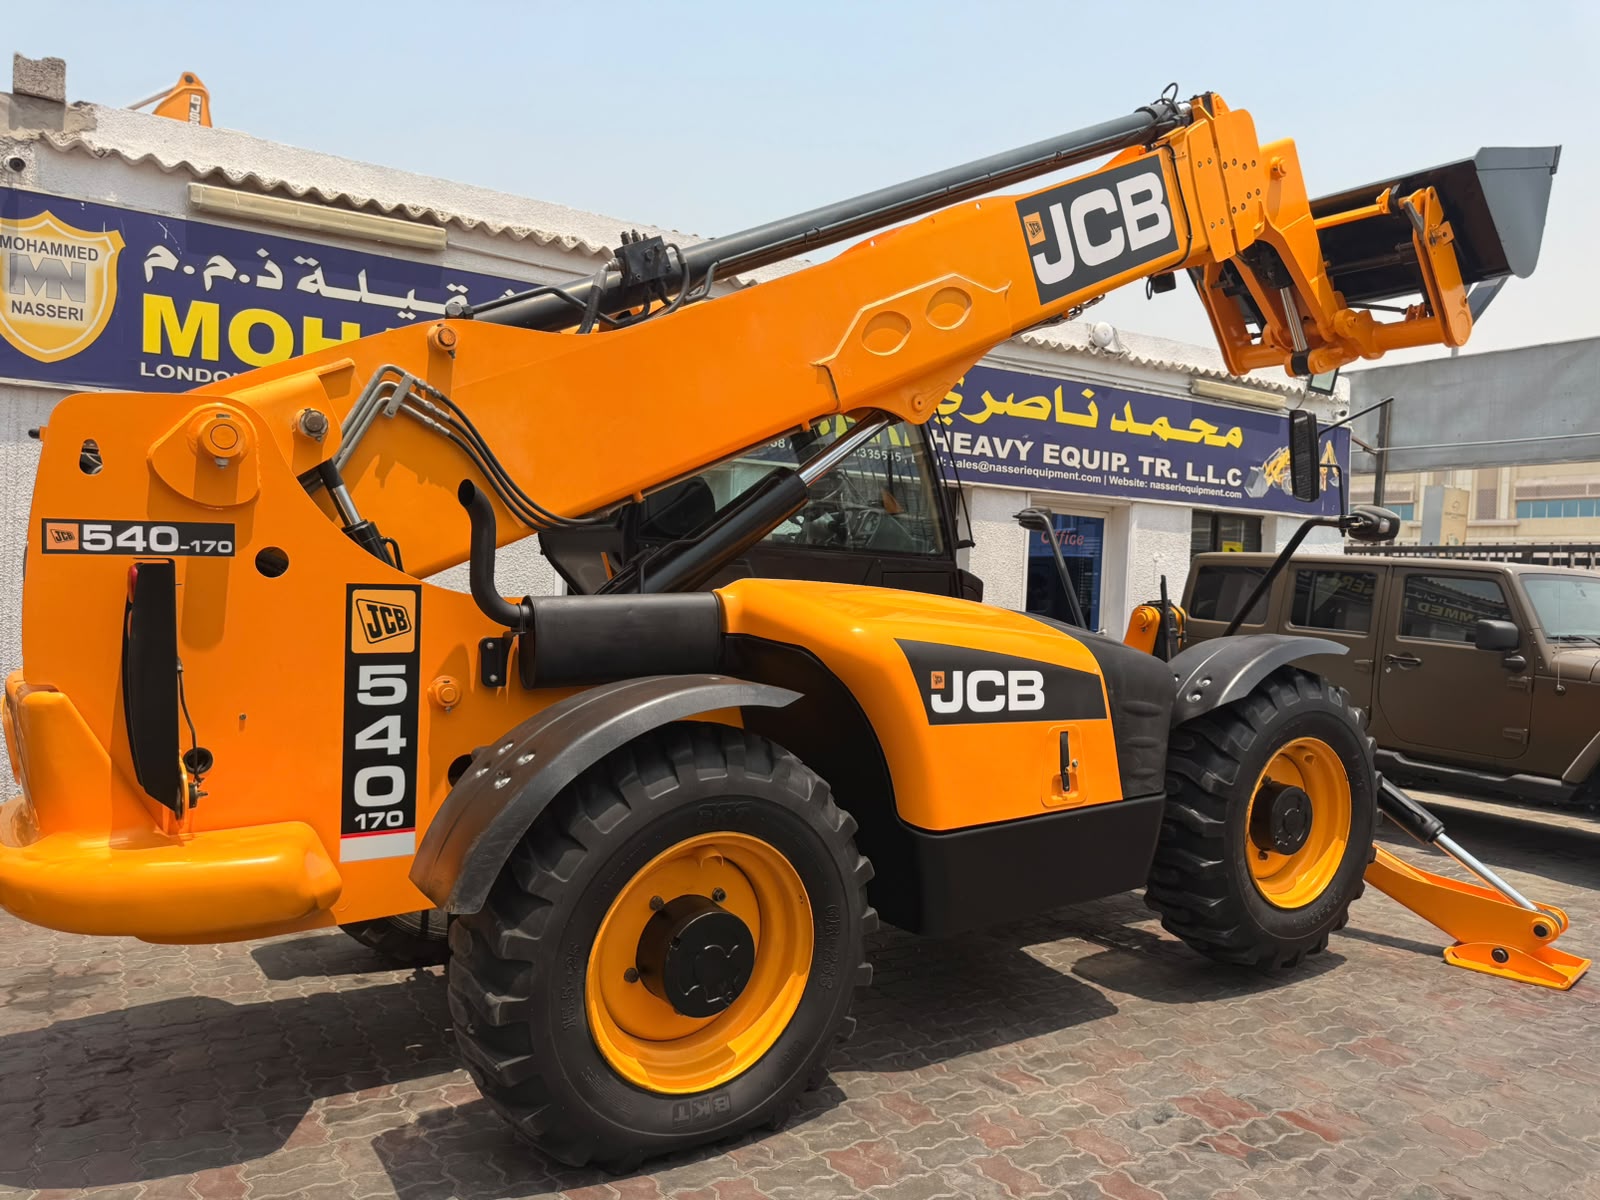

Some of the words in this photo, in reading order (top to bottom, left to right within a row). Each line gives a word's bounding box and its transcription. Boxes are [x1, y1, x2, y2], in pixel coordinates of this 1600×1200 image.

[1032, 171, 1172, 285] JCB
[0, 235, 99, 261] MOHAMMED
[11, 300, 84, 321] NASSERI
[142, 293, 362, 369] MOH
[140, 361, 240, 383] LONDO
[1110, 400, 1243, 449] محمد
[930, 429, 1034, 462] HEAVY
[1043, 443, 1130, 474] EQUIP.
[1138, 455, 1178, 479] TR.
[1186, 462, 1242, 487] L.L.C
[949, 456, 1102, 484] sales@nasseriequipment.com
[1109, 476, 1148, 488] Website:
[1150, 481, 1242, 499] nasseriequipment.com
[50, 529, 75, 543] JCB
[82, 524, 233, 553] 540-170
[365, 603, 409, 640] JCB
[931, 670, 1045, 713] JCB
[354, 811, 404, 830] 170
[673, 1095, 730, 1122] BKT
